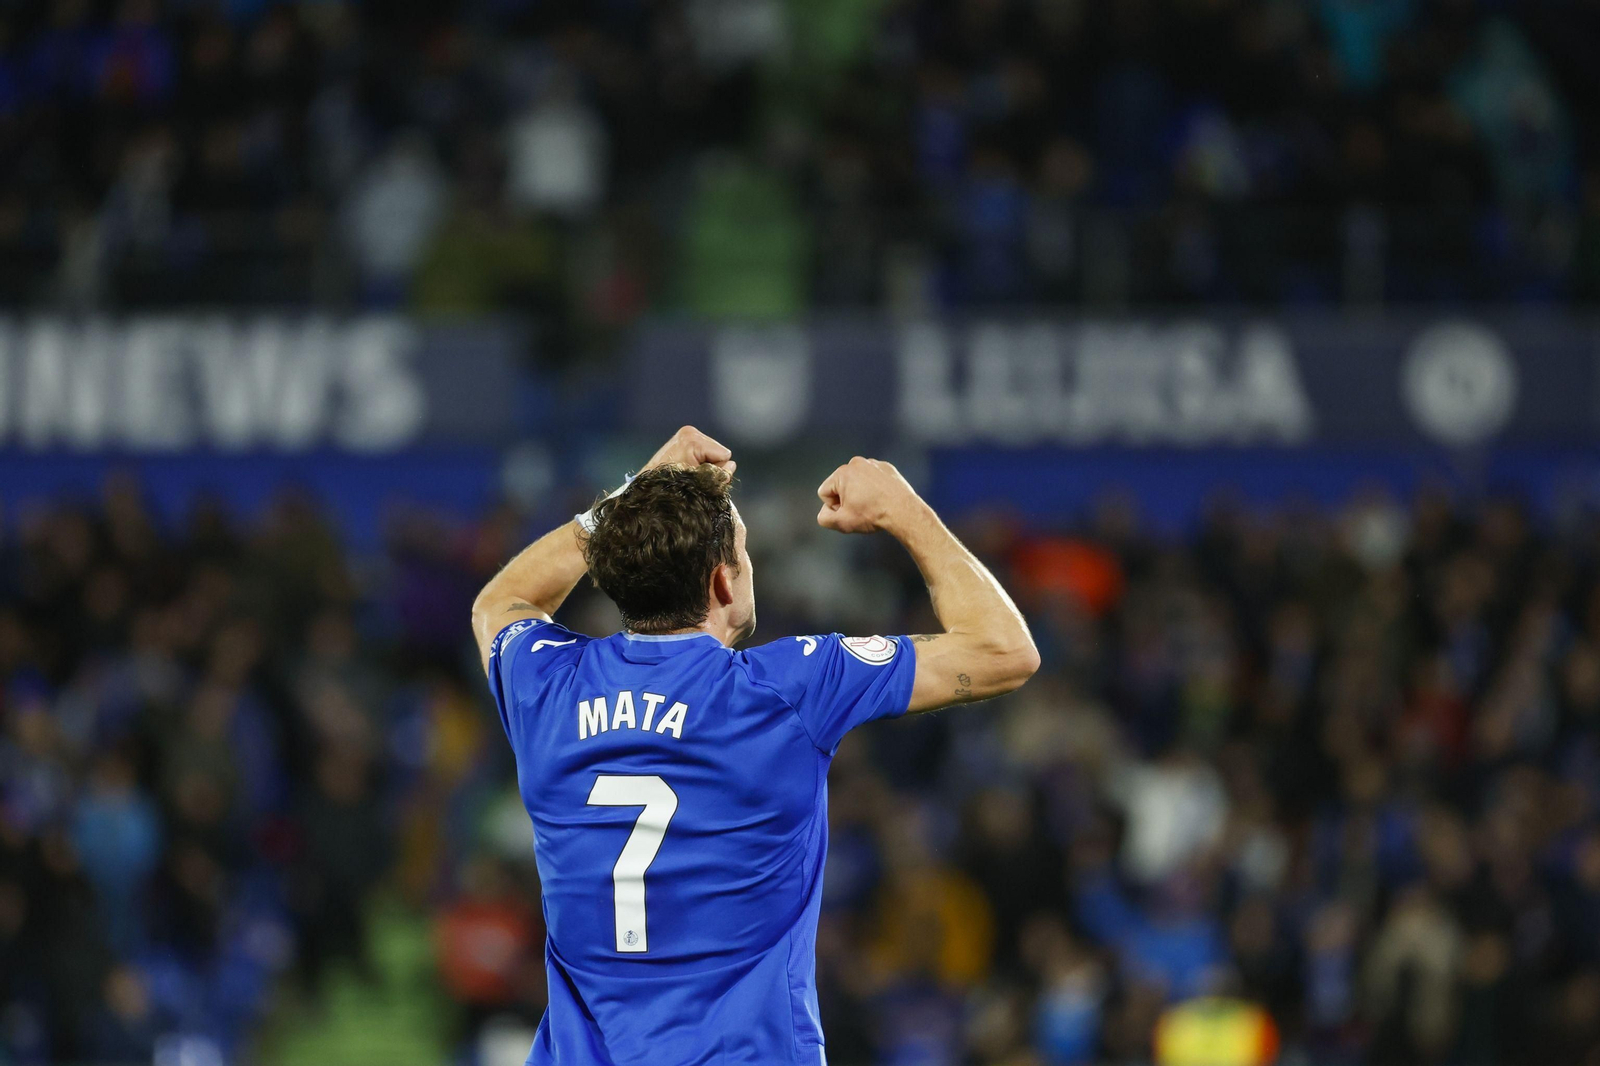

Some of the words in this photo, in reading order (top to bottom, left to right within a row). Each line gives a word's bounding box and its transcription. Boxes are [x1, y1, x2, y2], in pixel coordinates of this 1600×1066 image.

[0, 313, 424, 450] NEWS
[578, 690, 689, 741] MATA
[585, 774, 679, 953] 7
